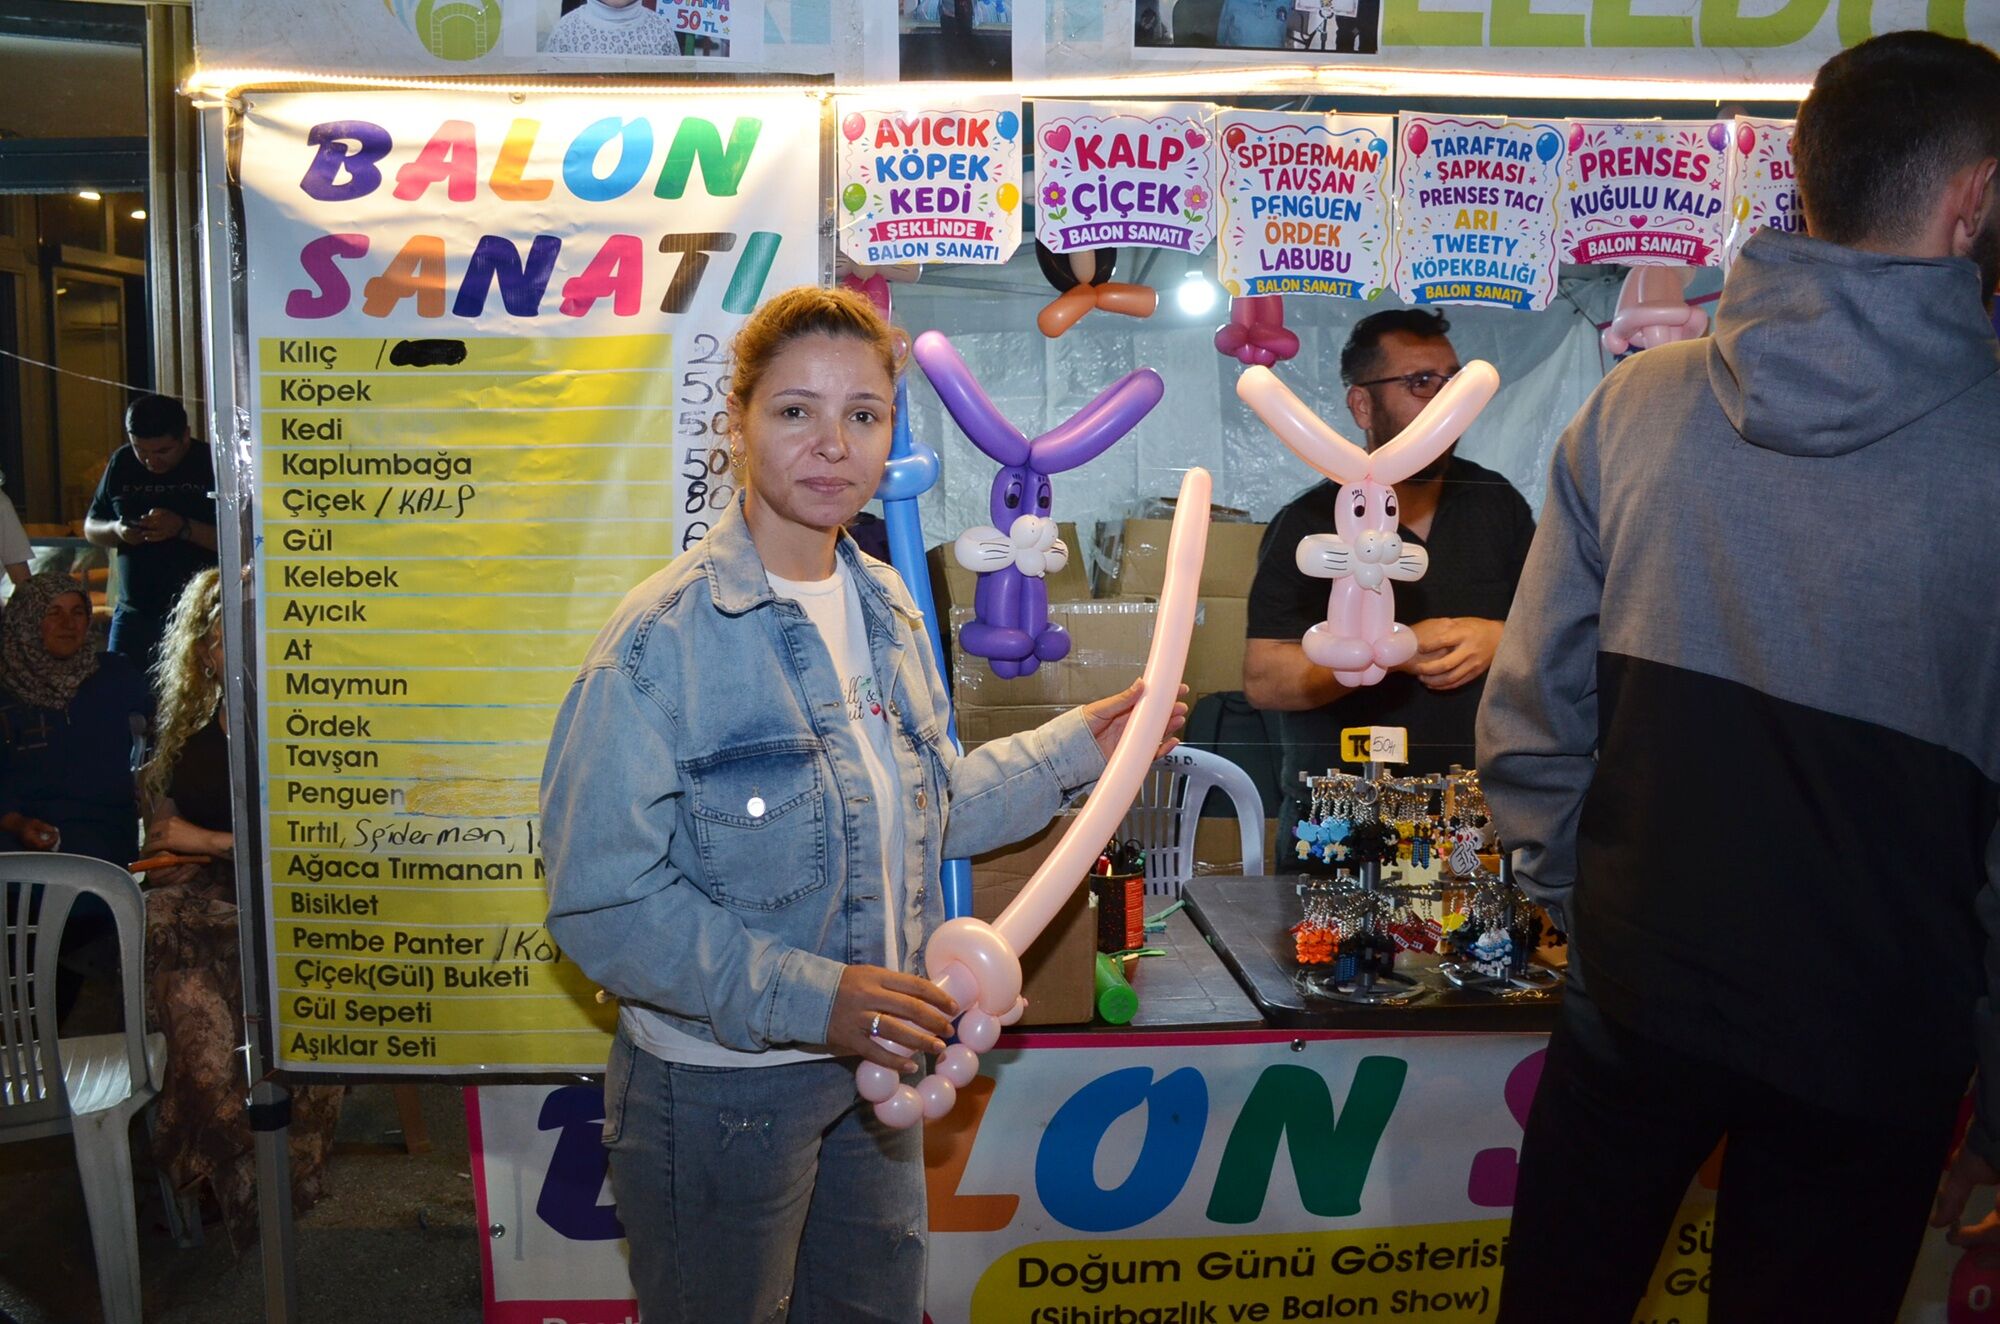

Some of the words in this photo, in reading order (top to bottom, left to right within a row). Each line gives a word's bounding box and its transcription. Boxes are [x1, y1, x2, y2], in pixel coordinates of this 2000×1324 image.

[676, 9, 702, 30] 50
[703, 20, 719, 33] TL
[874, 117, 990, 149] AYICIK
[300, 116, 762, 201] BALON
[1075, 134, 1185, 172] KALP
[1238, 142, 1379, 173] SPİDERMAN
[1431, 136, 1533, 162] TARAFTAR
[876, 149, 990, 183] KÖPEK
[1437, 160, 1525, 185] ŞAPKASI
[1579, 147, 1711, 183] PRENSES
[1258, 168, 1355, 194] TAVŞAN
[889, 183, 972, 214] KEDİ
[1072, 175, 1181, 221] ÇİÇEK
[1251, 195, 1362, 222] PENGUEN
[1419, 187, 1499, 208] PRENSES
[1504, 189, 1544, 213] TACI
[1570, 185, 1658, 218] KUĞULU
[1664, 187, 1722, 219] KALP
[887, 218, 977, 243] ŞEKLİNDE
[1265, 216, 1341, 247] ÖRDEK
[1454, 209, 1498, 231] ARI
[1069, 224, 1125, 245] BALON
[1128, 224, 1184, 245] SANATI
[1432, 234, 1519, 257] TWEETY
[1588, 236, 1637, 257] BALON
[1640, 236, 1696, 257] SANATI
[868, 242, 930, 262] BALON
[935, 242, 998, 261] SANATI
[1260, 248, 1351, 273] LABUBU
[285, 231, 782, 319] SANATI
[1412, 257, 1536, 285] KÖPEKBALIĞI
[1256, 278, 1301, 293] BALON
[1302, 278, 1353, 296] SANATI
[1425, 284, 1471, 299] BALON
[1475, 285, 1523, 303] SANATI
[279, 341, 337, 369] Kılıç
[280, 379, 371, 405] Köpek
[281, 418, 342, 441] Kedi
[282, 451, 472, 479] Kaplumbağa
[682, 448, 730, 481] 50
[282, 489, 366, 517] Çiçek
[686, 481, 735, 514] 80
[283, 529, 333, 551] Gül
[284, 566, 398, 588] Kelebek
[283, 600, 366, 627] Ayıcık
[284, 639, 312, 661] At
[286, 673, 407, 700] Maymun
[286, 710, 370, 737] Ördek
[286, 745, 378, 773] Tavşan
[288, 782, 404, 809] Penguen
[287, 855, 379, 882] Ağaca
[388, 857, 522, 881] Tırmanan
[291, 892, 378, 916] Bisiklet
[294, 927, 384, 952] Pembe
[395, 931, 483, 955] Panter
[295, 960, 434, 992] Çiçek(Gül)
[445, 965, 528, 988] Buketi
[294, 996, 335, 1021] Gül
[345, 1000, 431, 1027] Sepeti
[291, 1032, 378, 1061] Aşıklar
[387, 1035, 436, 1057] Seti
[1018, 1253, 1181, 1294] Doğum
[1197, 1247, 1315, 1281] Günü
[1228, 1303, 1270, 1323] ve
[1283, 1293, 1378, 1320] Balon
[1390, 1285, 1490, 1315] Show)
